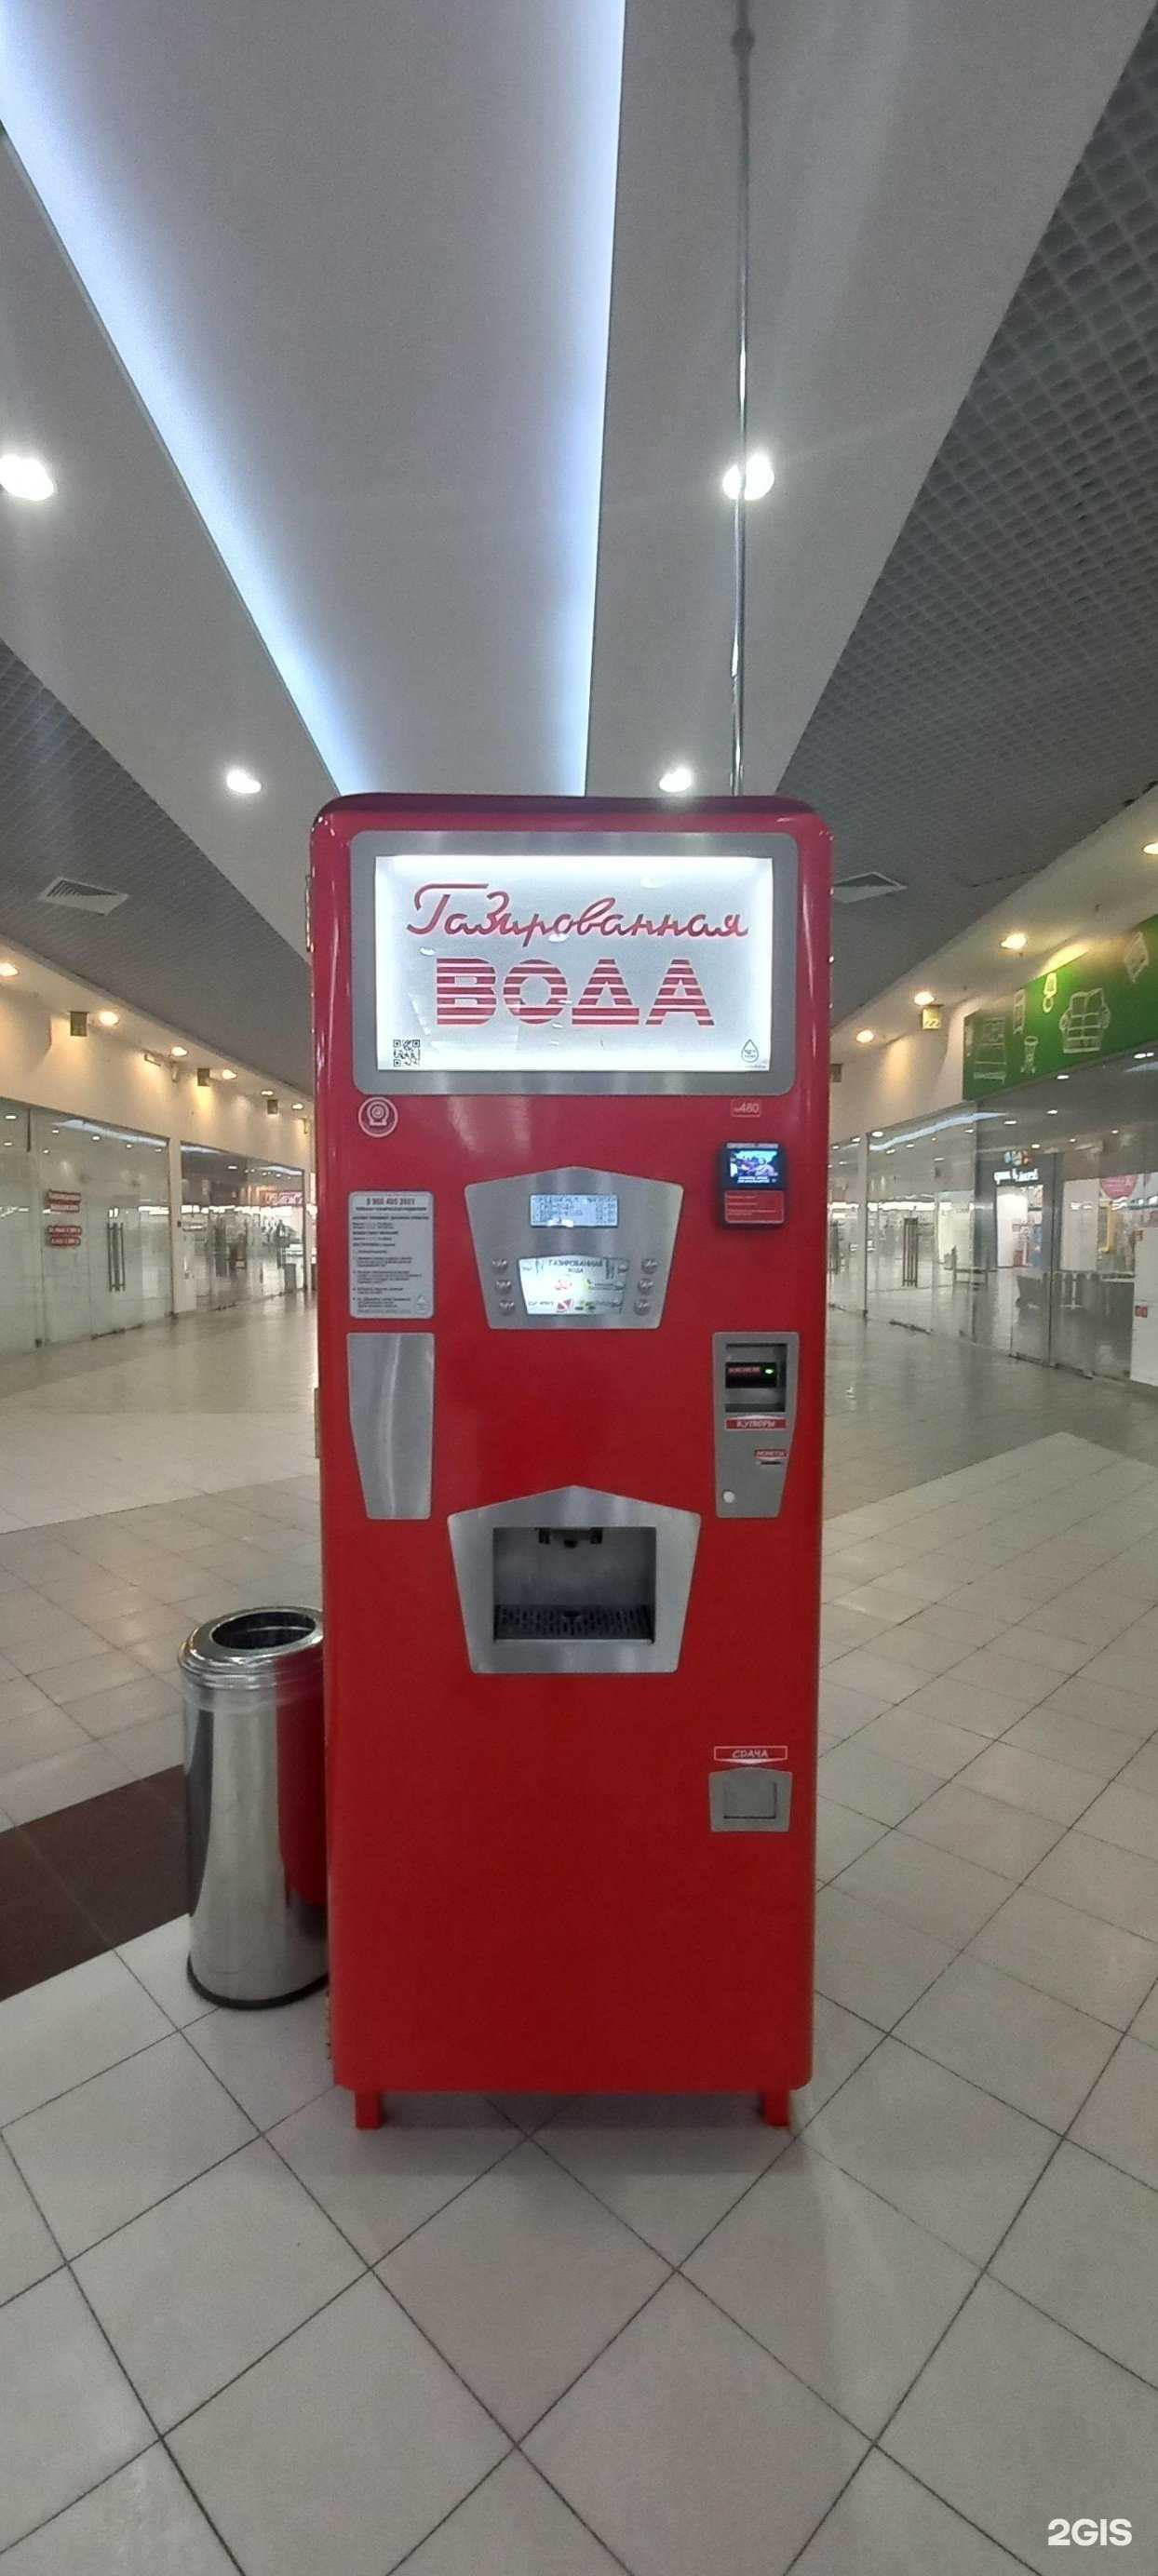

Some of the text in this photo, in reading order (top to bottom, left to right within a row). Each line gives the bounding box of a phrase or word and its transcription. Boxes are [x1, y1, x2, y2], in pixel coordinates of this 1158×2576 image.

[407, 882, 748, 946] Газированная
[437, 958, 715, 1026] ВОДА
[732, 1749, 769, 1758] СДАЧА
